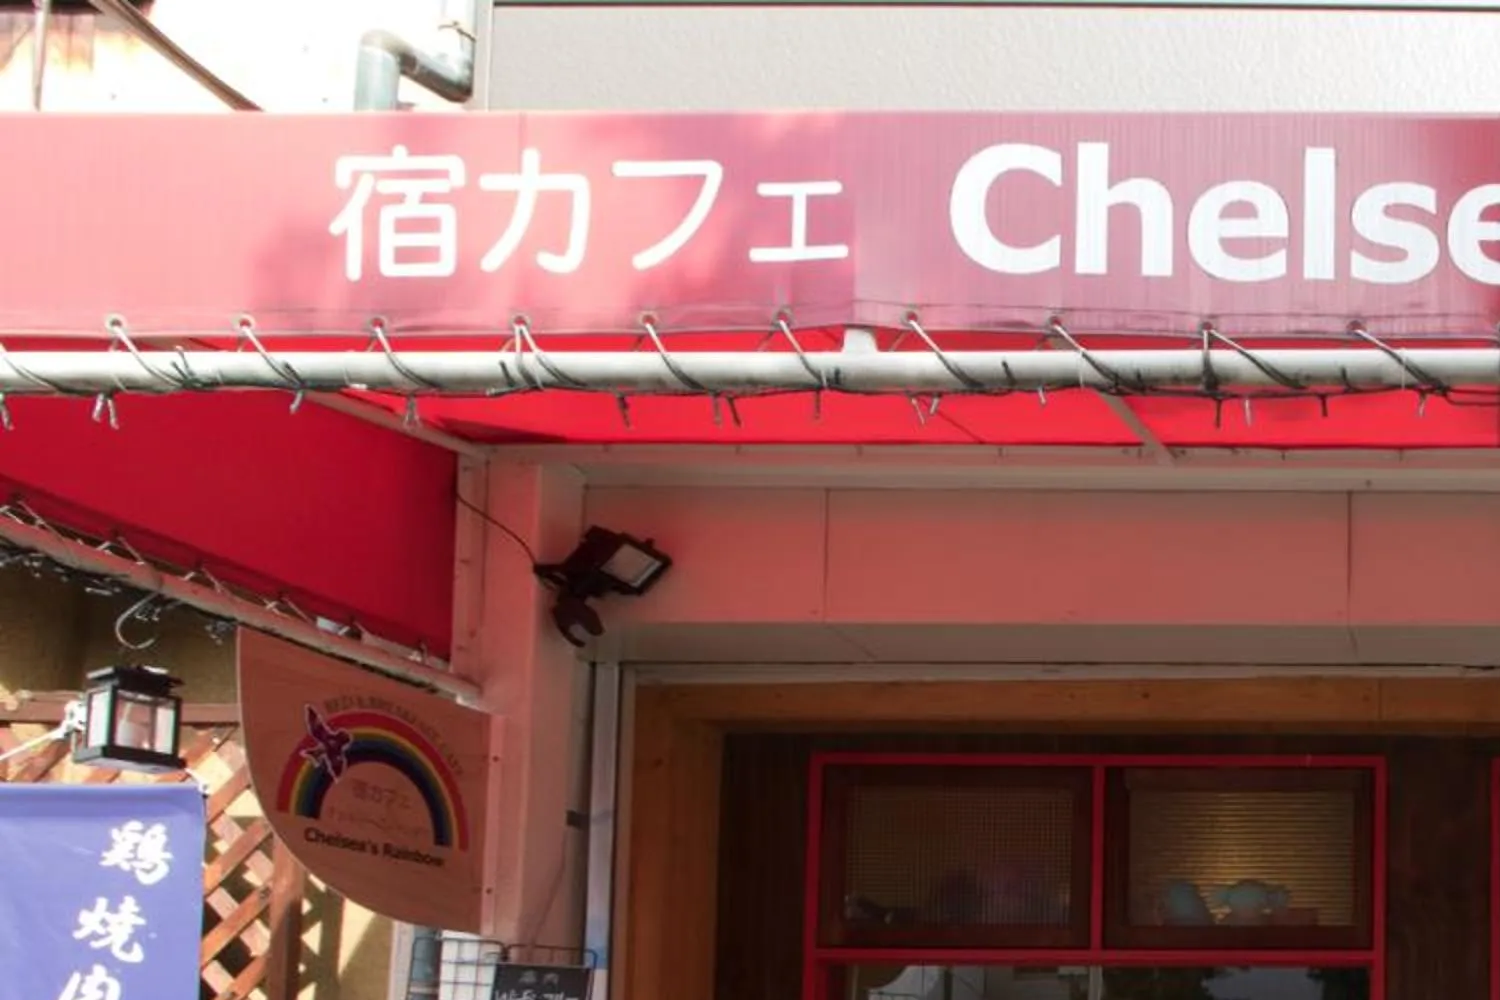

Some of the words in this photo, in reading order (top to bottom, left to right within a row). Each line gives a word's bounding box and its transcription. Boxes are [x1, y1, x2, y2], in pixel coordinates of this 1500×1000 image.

[329, 145, 850, 282] 宿カフェ
[382, 842, 446, 869] Rainbow
